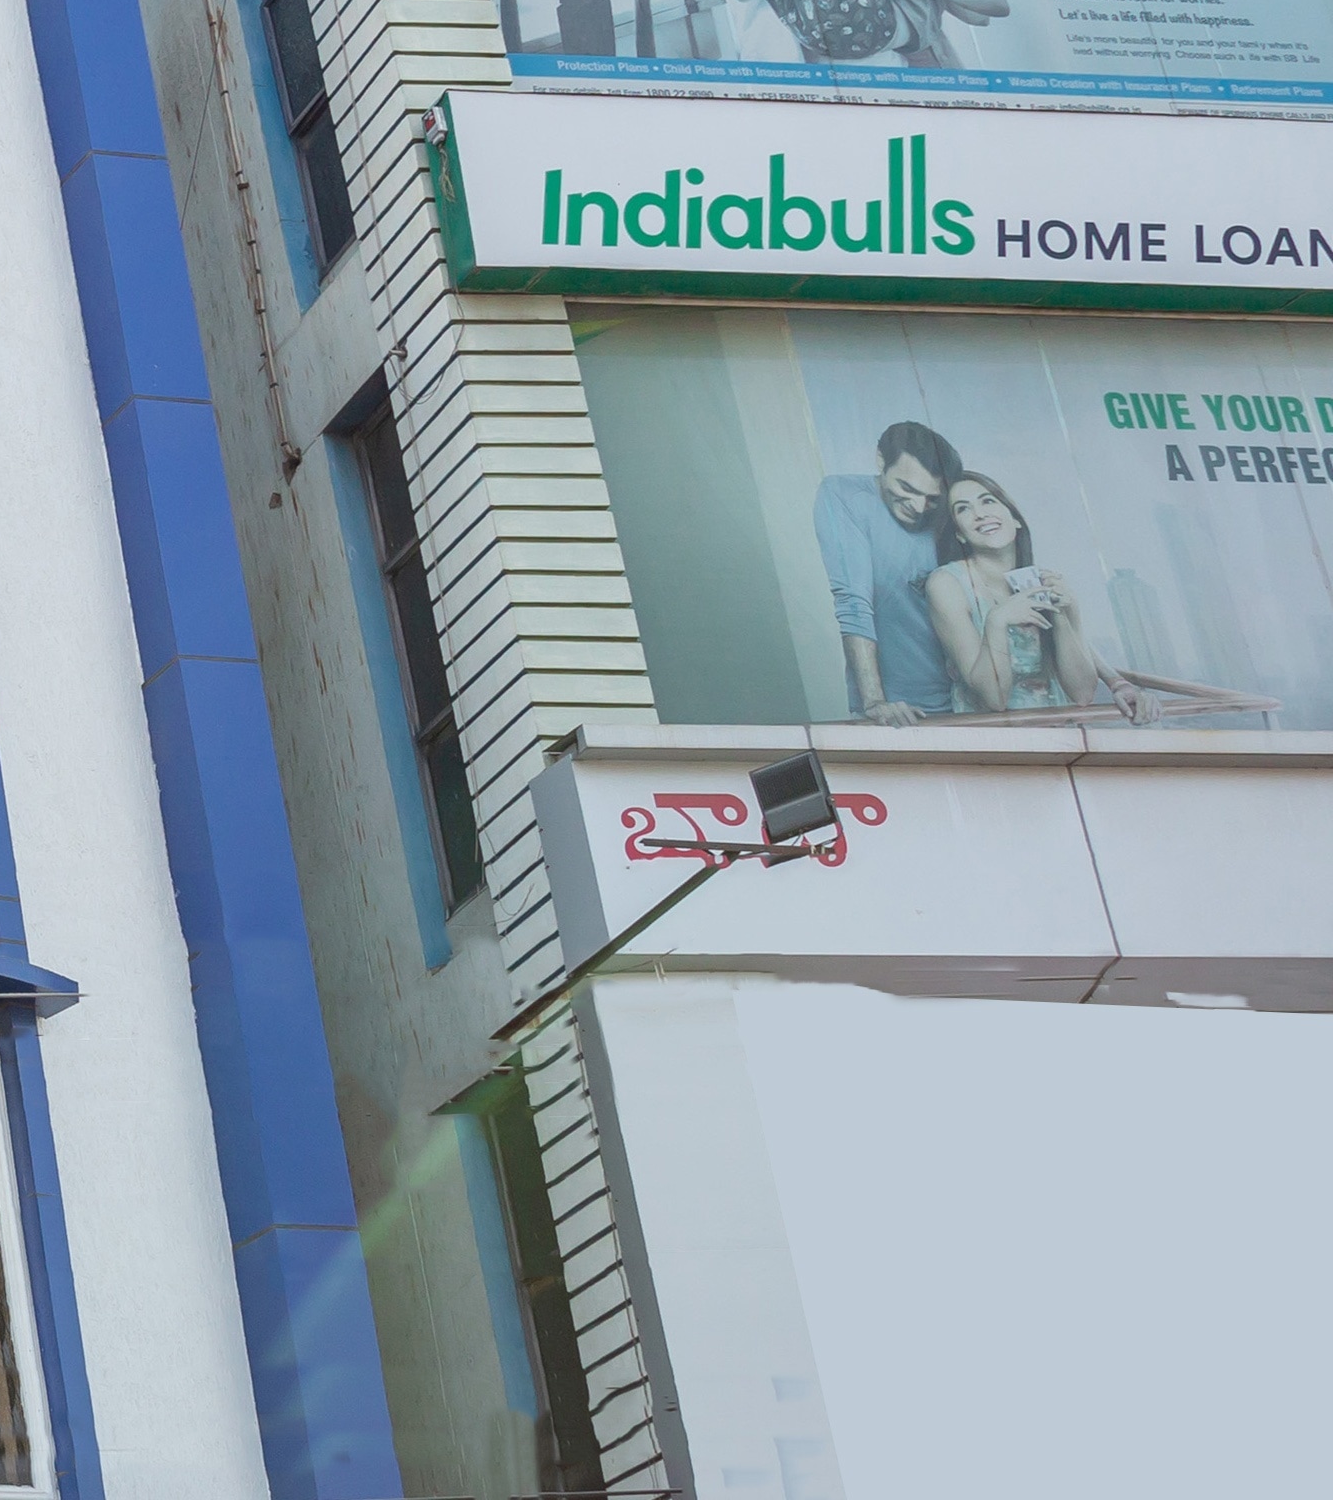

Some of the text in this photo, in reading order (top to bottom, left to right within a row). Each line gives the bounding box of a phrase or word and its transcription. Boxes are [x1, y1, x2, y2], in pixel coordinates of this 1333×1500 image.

[1058, 8, 1088, 20] Let's
[1089, 9, 1109, 21] live
[1111, 13, 1119, 22] a
[1119, 10, 1137, 23] life
[1168, 12, 1193, 25] with
[1284, 54, 1298, 63] SB
[556, 59, 1324, 98] Protection Plans Child Plans with Insurance Savings with Insurance Plans Wealth Creation with Insurance Plans Retirement Plans
[541, 133, 1333, 268] Indiabulls HOME LOAN
[1103, 391, 1196, 431] GIVE
[1202, 393, 1311, 433] YOUR
[1165, 443, 1194, 481] A
